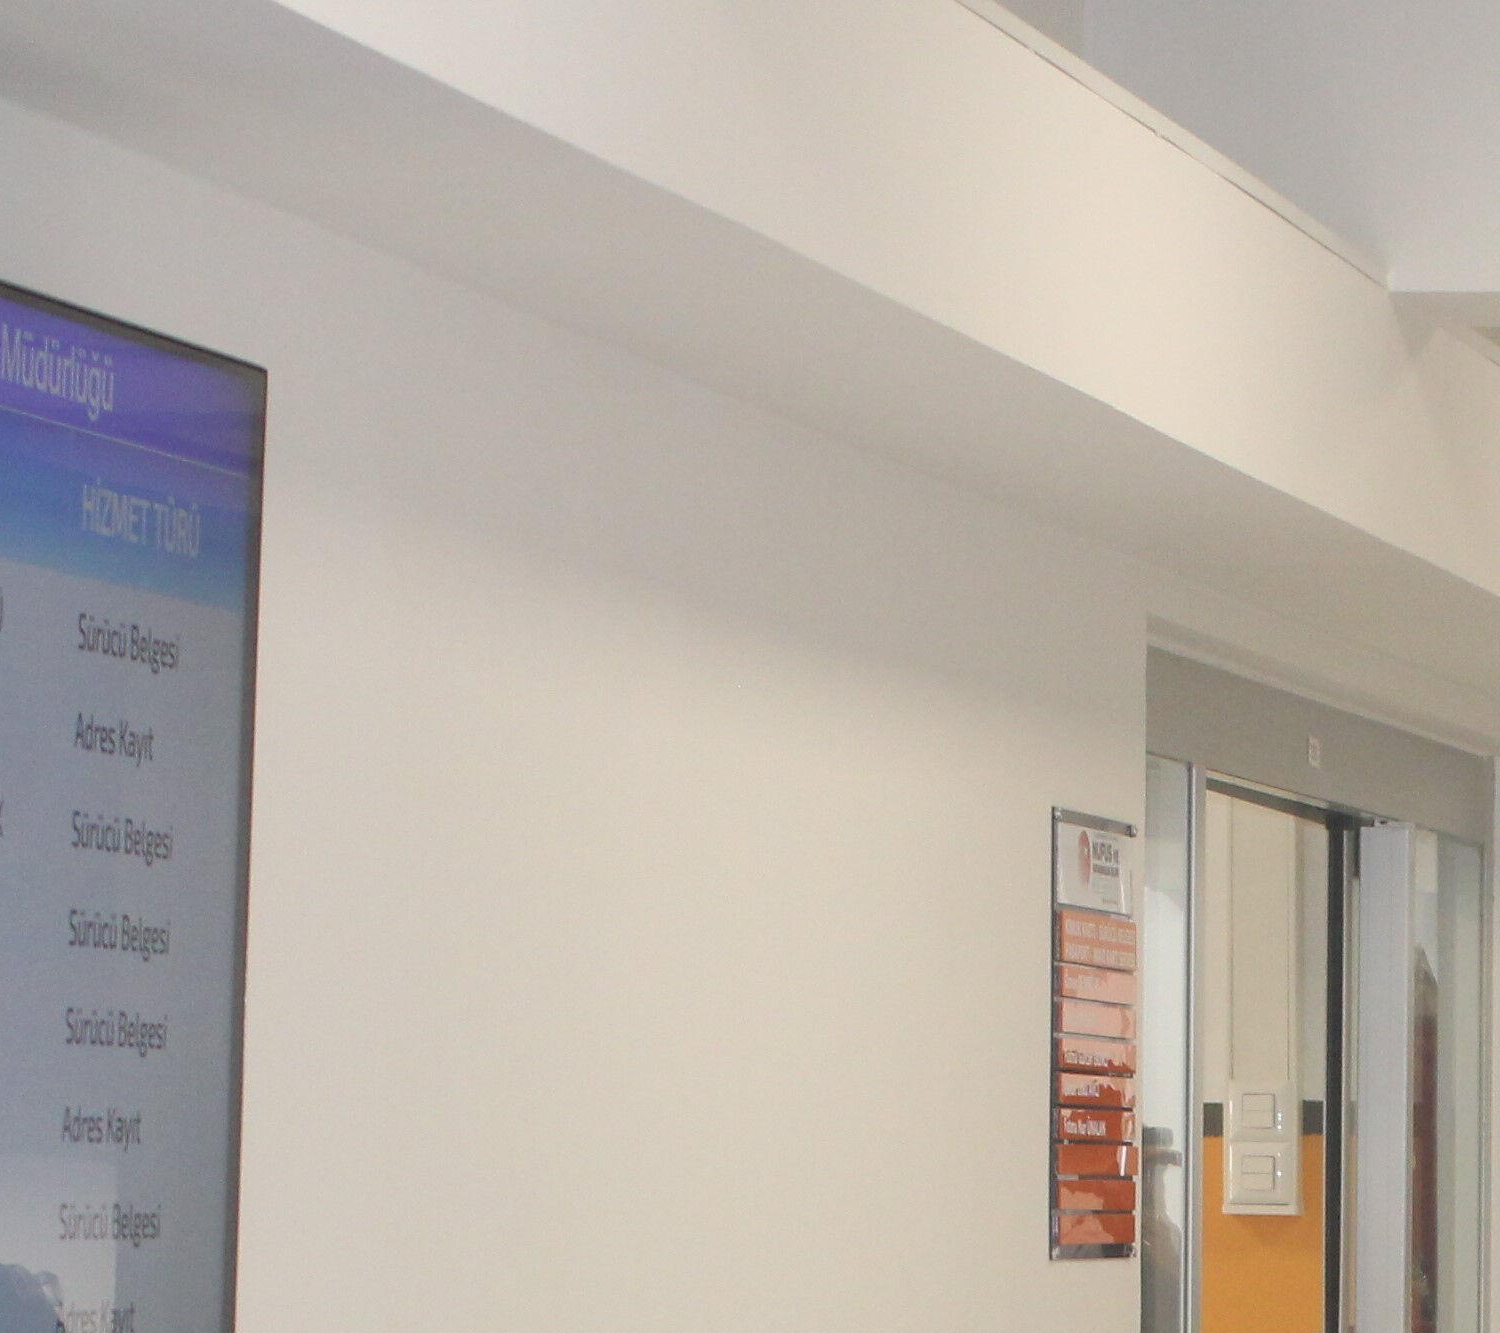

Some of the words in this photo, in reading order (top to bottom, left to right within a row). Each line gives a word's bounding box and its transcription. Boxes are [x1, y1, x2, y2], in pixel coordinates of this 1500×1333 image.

[1, 323, 115, 421] Müdürlüğü
[81, 479, 151, 545] HİZMET
[77, 612, 127, 658] Sürücü
[129, 623, 180, 674] Belgesi
[75, 711, 116, 755] Adres
[118, 720, 154, 767] Kayıt
[71, 809, 121, 853] Sürücü
[123, 817, 174, 866] Belgesi
[68, 908, 119, 950] Sürücü
[121, 913, 171, 962] Belgesi
[65, 1006, 115, 1047] Sürücü
[117, 1010, 168, 1058] Belgesi
[61, 1104, 103, 1144] Adres
[105, 1107, 141, 1151] Kayıt
[58, 1203, 108, 1242] Sürücü
[112, 1203, 162, 1248] Belgesi
